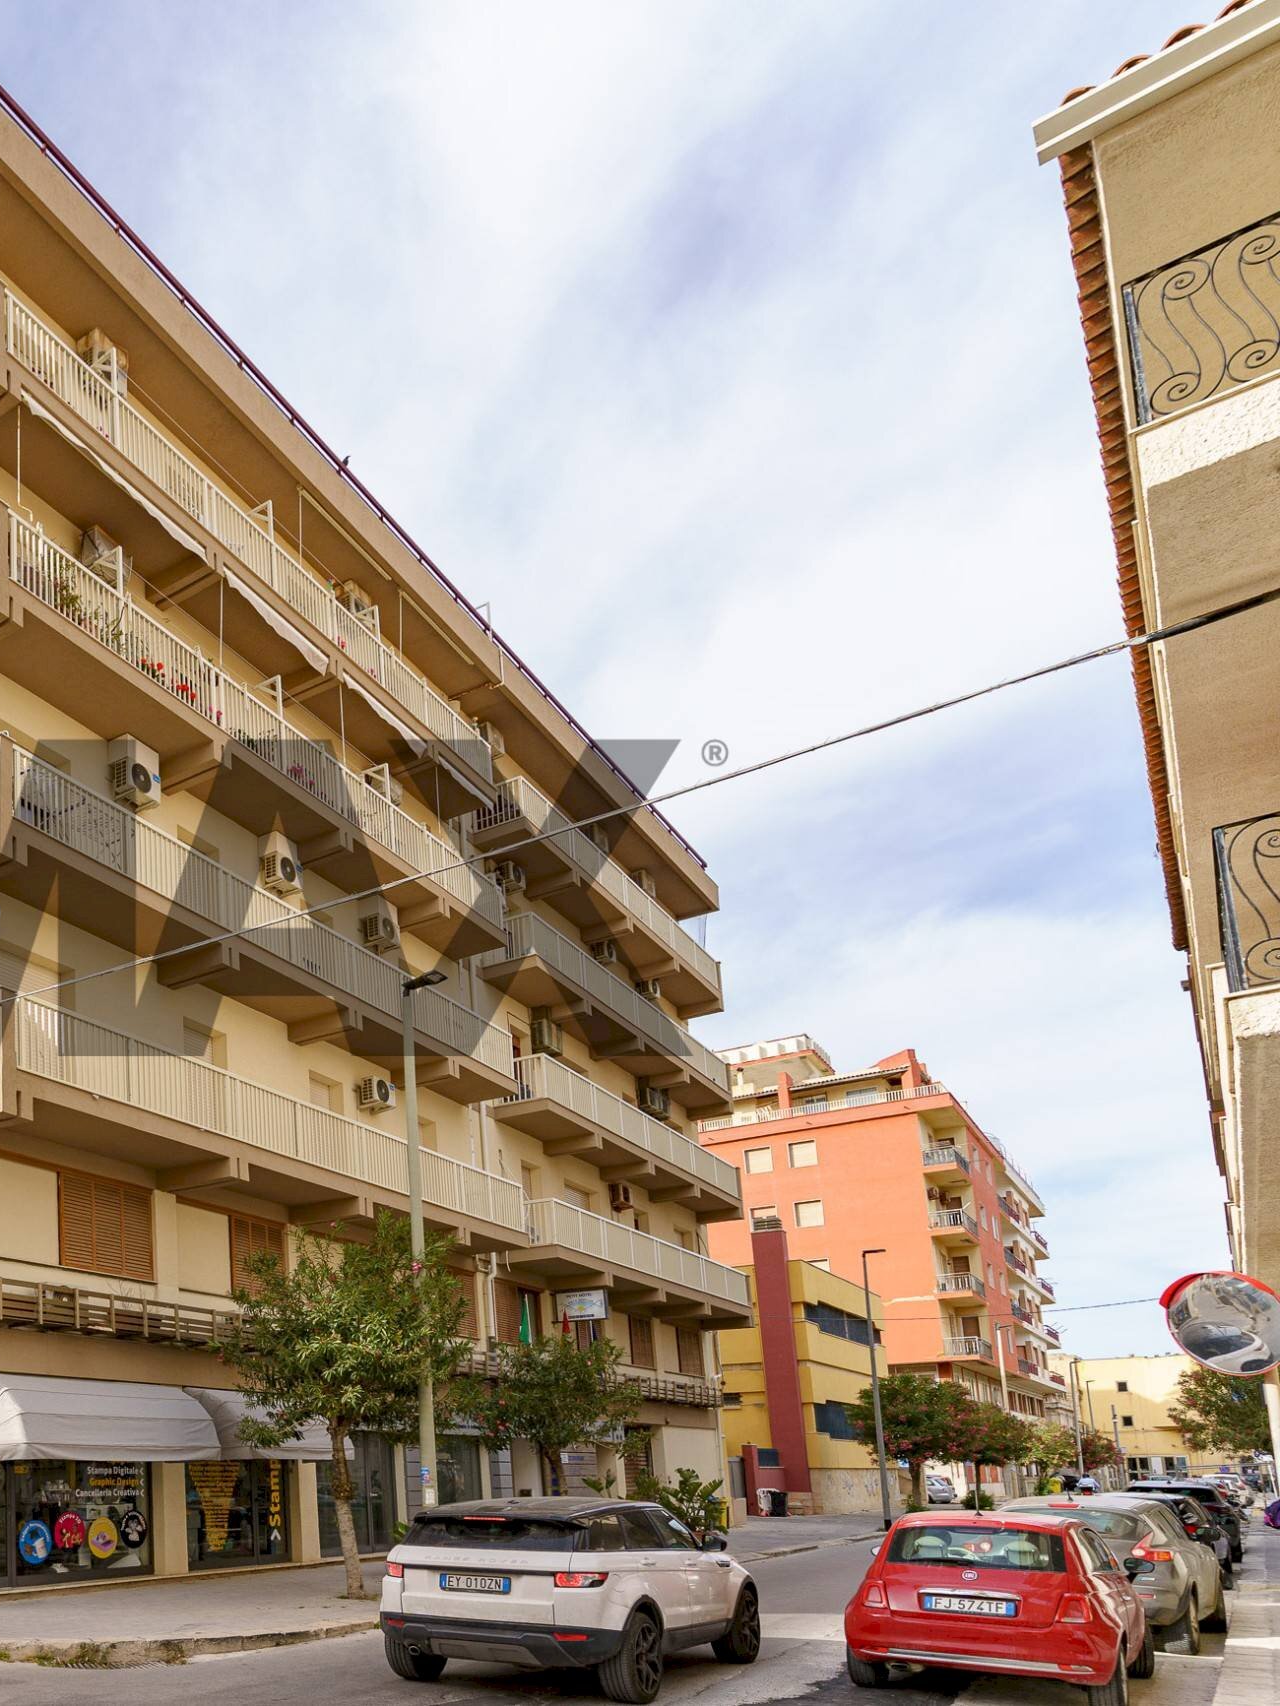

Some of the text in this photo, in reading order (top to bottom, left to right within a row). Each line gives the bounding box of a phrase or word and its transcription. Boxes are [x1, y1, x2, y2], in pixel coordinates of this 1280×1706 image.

[87, 1466, 138, 1476] Stampa Digitale
[89, 1477, 139, 1487] Graphic Design
[75, 1487, 140, 1497] Cancelleria Creativa
[447, 1576, 502, 1590] EY 010ZN
[934, 1598, 1004, 1612] FJ 574TF
